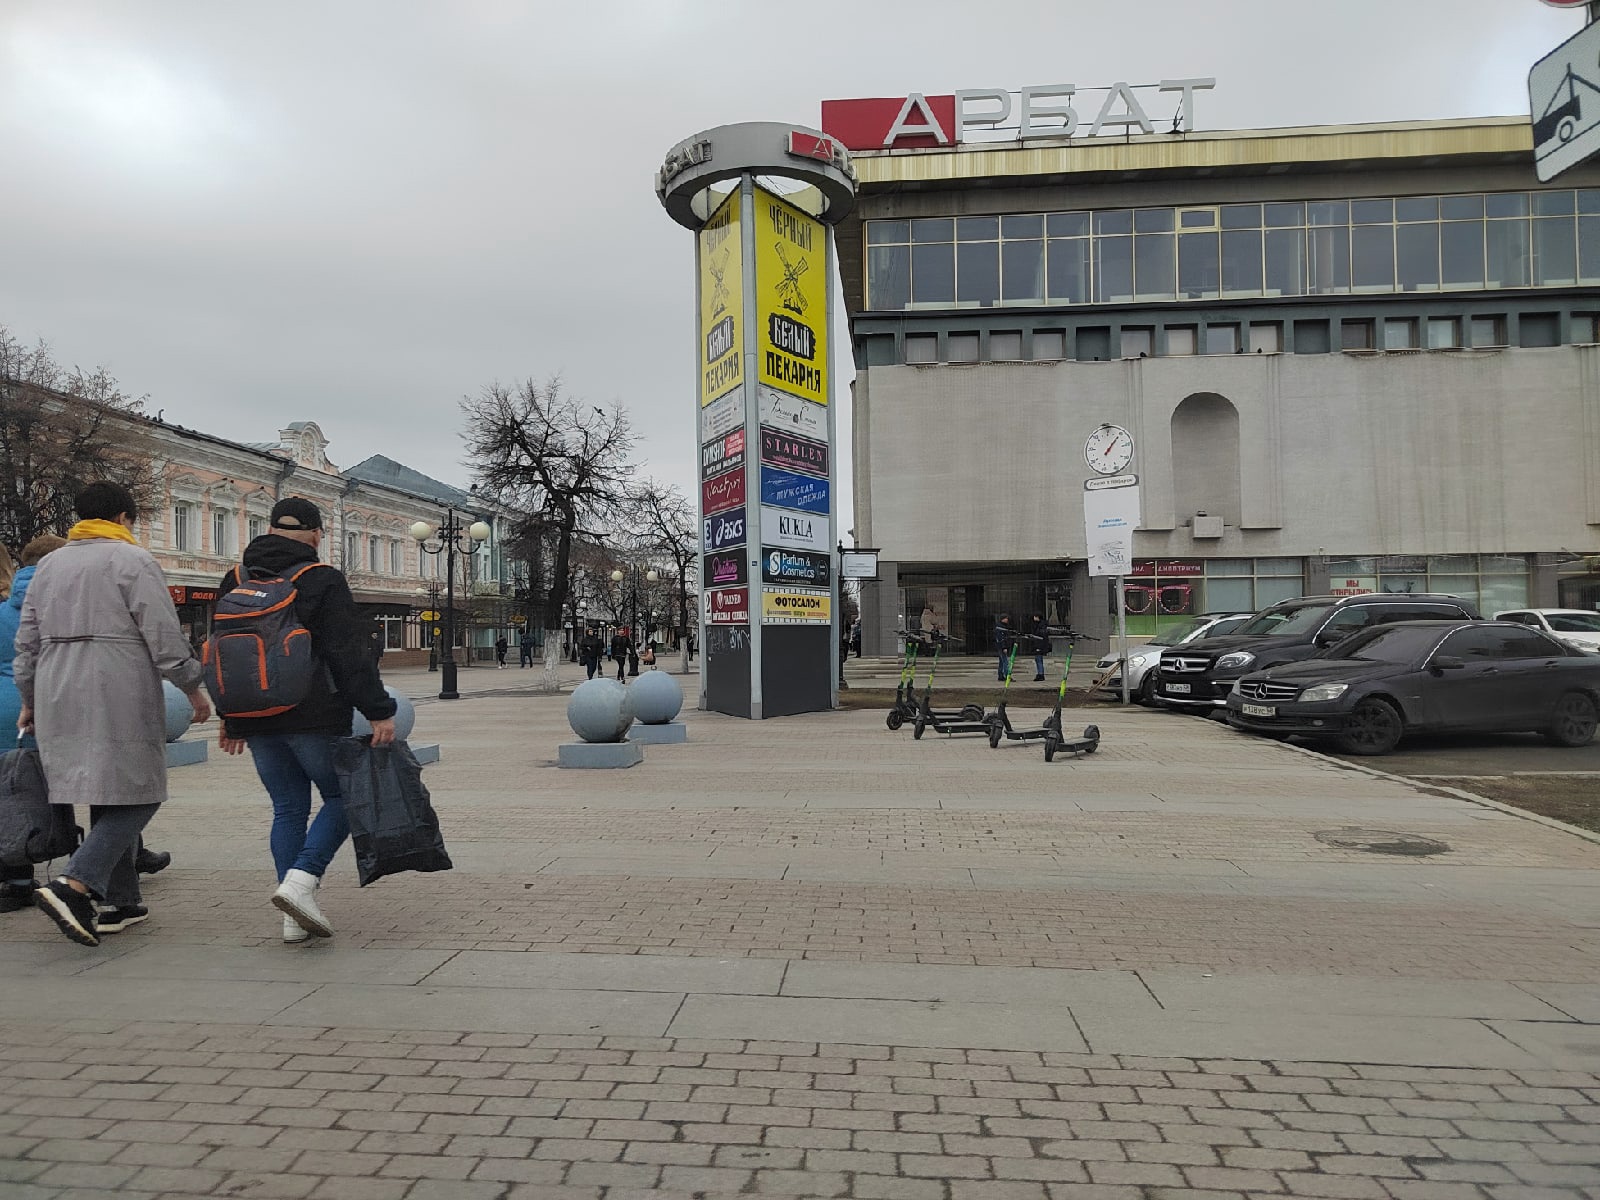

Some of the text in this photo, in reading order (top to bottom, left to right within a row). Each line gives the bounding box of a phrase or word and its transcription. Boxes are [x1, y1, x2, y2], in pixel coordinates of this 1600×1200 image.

[883, 77, 1216, 146] АРБАТ
[769, 202, 812, 252] ЧЁРНЫЙ
[774, 316, 810, 358] БЕЛЫЙ
[705, 351, 739, 396] ПЕКАРНЯ
[766, 350, 821, 394] ПЕКАРНЯ
[776, 484, 814, 500] МУЖСКАЯ
[705, 522, 711, 541] 3
[779, 515, 813, 538] KUKLA
[782, 565, 815, 579] Cosmetics
[705, 593, 711, 613] 2
[775, 596, 820, 609] ФОТОСАЛОН
